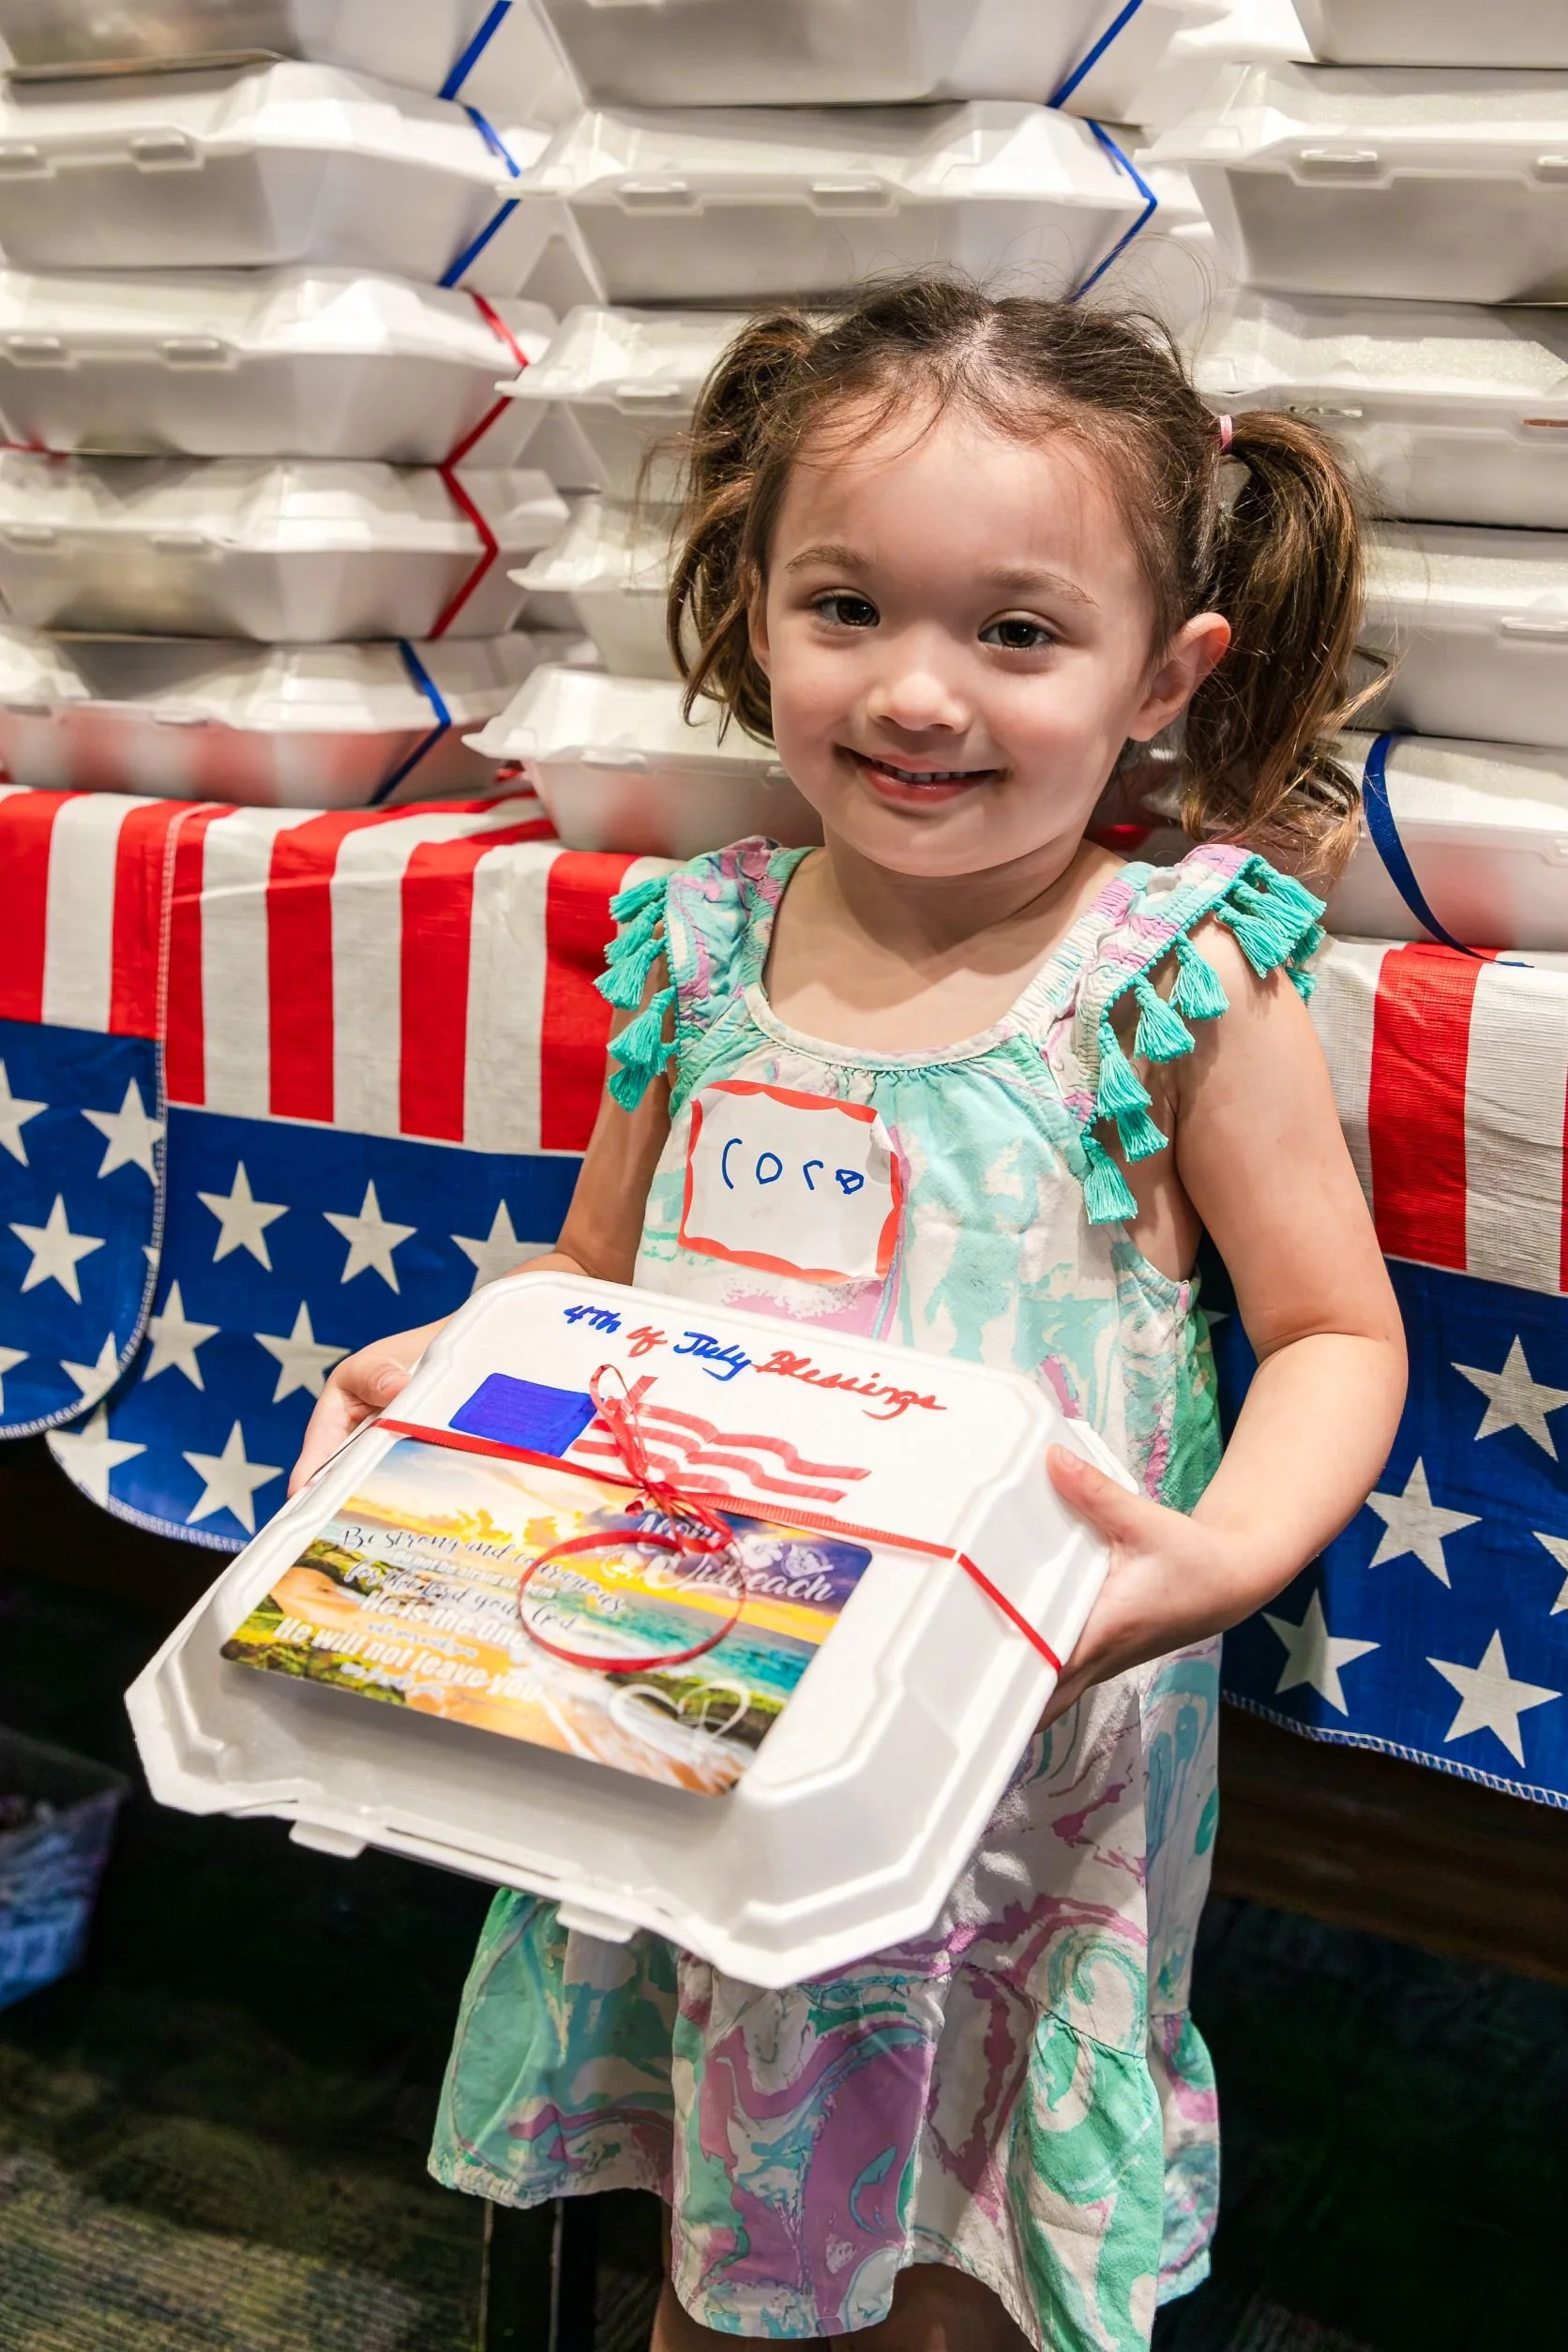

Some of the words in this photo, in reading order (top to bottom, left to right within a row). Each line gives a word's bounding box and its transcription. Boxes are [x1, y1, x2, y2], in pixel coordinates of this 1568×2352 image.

[626, 1326, 668, 1357] of
[673, 1332, 751, 1381] July
[753, 1349, 947, 1420] Blessings
[342, 1526, 376, 1549] Be
[385, 1530, 459, 1554] strong
[466, 1541, 516, 1560] and
[359, 1589, 400, 1616] He
[398, 1598, 427, 1622] is
[427, 1606, 475, 1636] the
[475, 1619, 526, 1651] One
[272, 1617, 313, 1644] He
[310, 1627, 368, 1656] will
[362, 1642, 415, 1668] not
[408, 1650, 488, 1688] leave
[486, 1673, 543, 1703] you
